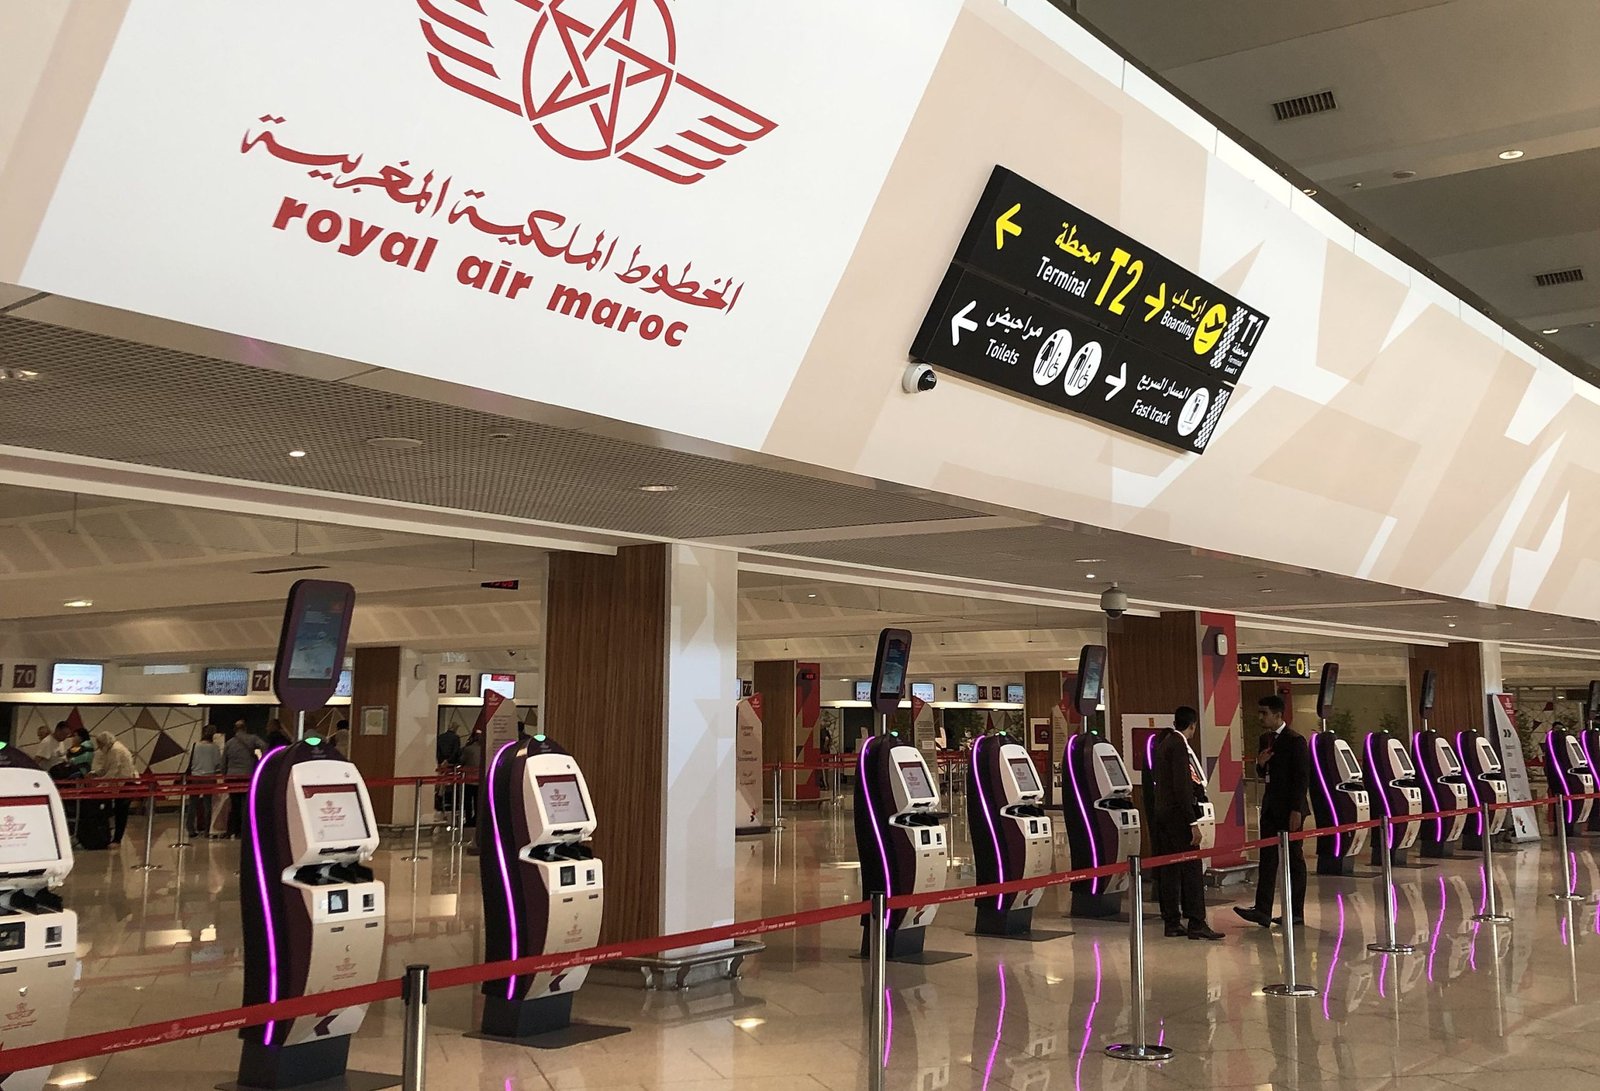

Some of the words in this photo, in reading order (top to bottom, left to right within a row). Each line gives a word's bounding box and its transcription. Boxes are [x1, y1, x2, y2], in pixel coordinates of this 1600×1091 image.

[240, 115, 451, 216] المغربية
[447, 190, 618, 271] الملكية
[1054, 221, 1101, 265] محطة
[272, 196, 438, 273] royal
[456, 256, 533, 300] air
[547, 284, 689, 347] maroc
[616, 246, 744, 314] الخطوط
[1036, 256, 1091, 299] Terminal
[1094, 247, 1144, 315] T2
[985, 305, 1043, 341] مراحيض
[1160, 310, 1195, 341] Boarding
[1240, 314, 1264, 347] T1
[985, 338, 1020, 365] Toilets
[1137, 374, 1168, 392] السريع
[1163, 381, 1192, 400] المسار
[1131, 399, 1152, 418] Fast
[1149, 406, 1172, 426] track
[16, 669, 35, 684] 70
[255, 674, 269, 688] 71
[456, 678, 470, 691] 74
